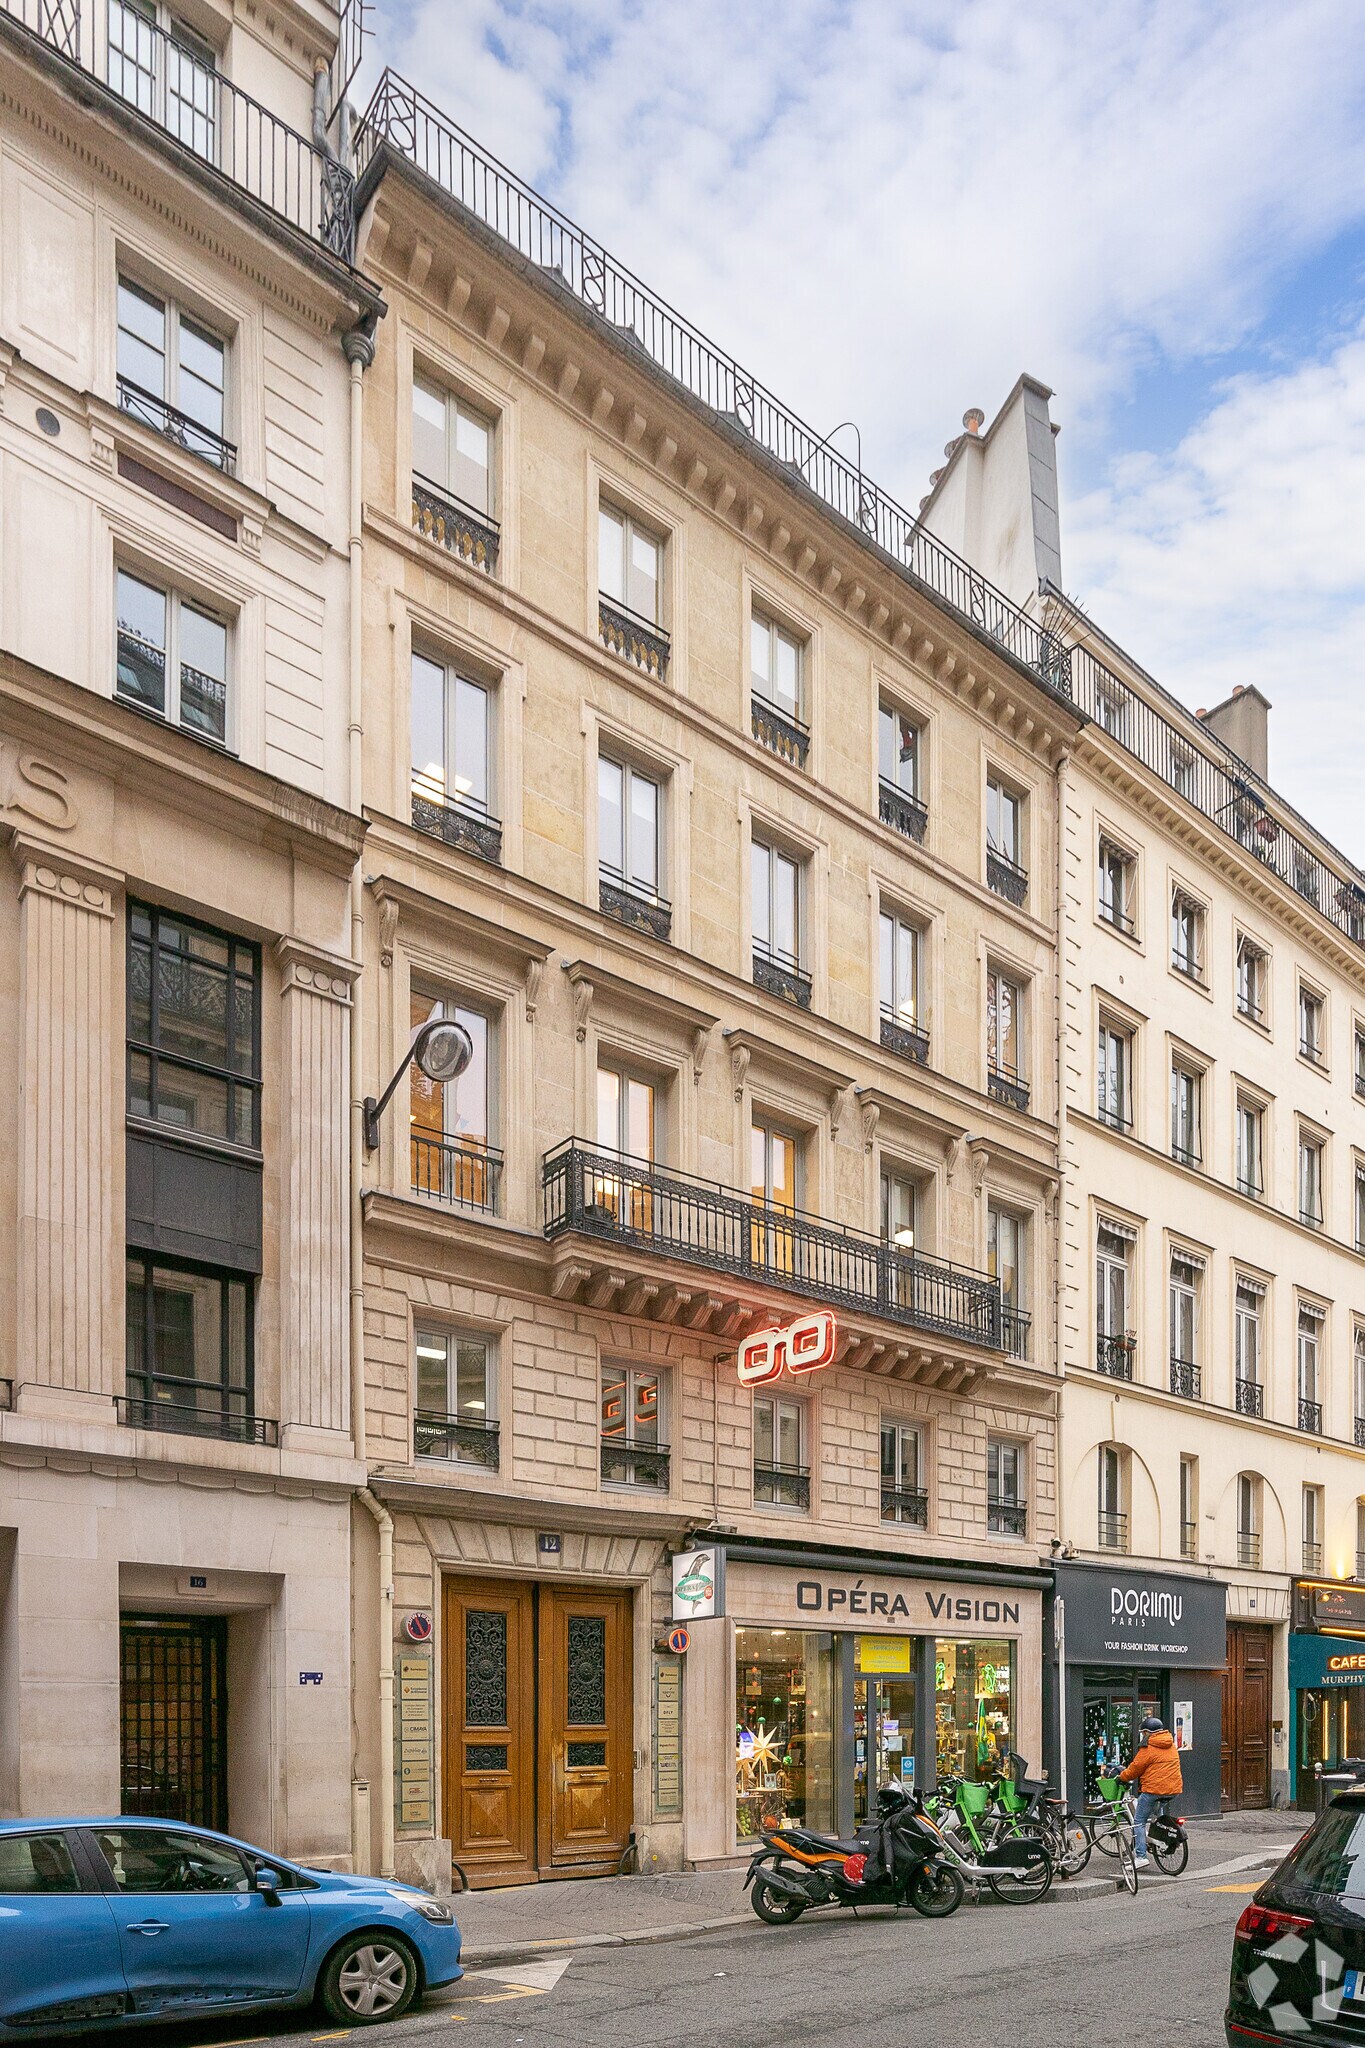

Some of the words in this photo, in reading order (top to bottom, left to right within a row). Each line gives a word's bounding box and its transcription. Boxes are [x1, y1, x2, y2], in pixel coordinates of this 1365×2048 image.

[1, 754, 79, 832] S
[544, 1536, 557, 1550] 12
[194, 1578, 204, 1587] 16
[796, 1579, 910, 1617] OPÉRA
[925, 1591, 1020, 1624] VISION
[1111, 1616, 1146, 1628] PARIS
[1104, 1641, 1120, 1650] YOUR
[1120, 1641, 1143, 1651] FASHION
[1143, 1643, 1160, 1652] DRINK
[1160, 1644, 1189, 1654] WORKSHOP
[1330, 1655, 1365, 1669] CAFE
